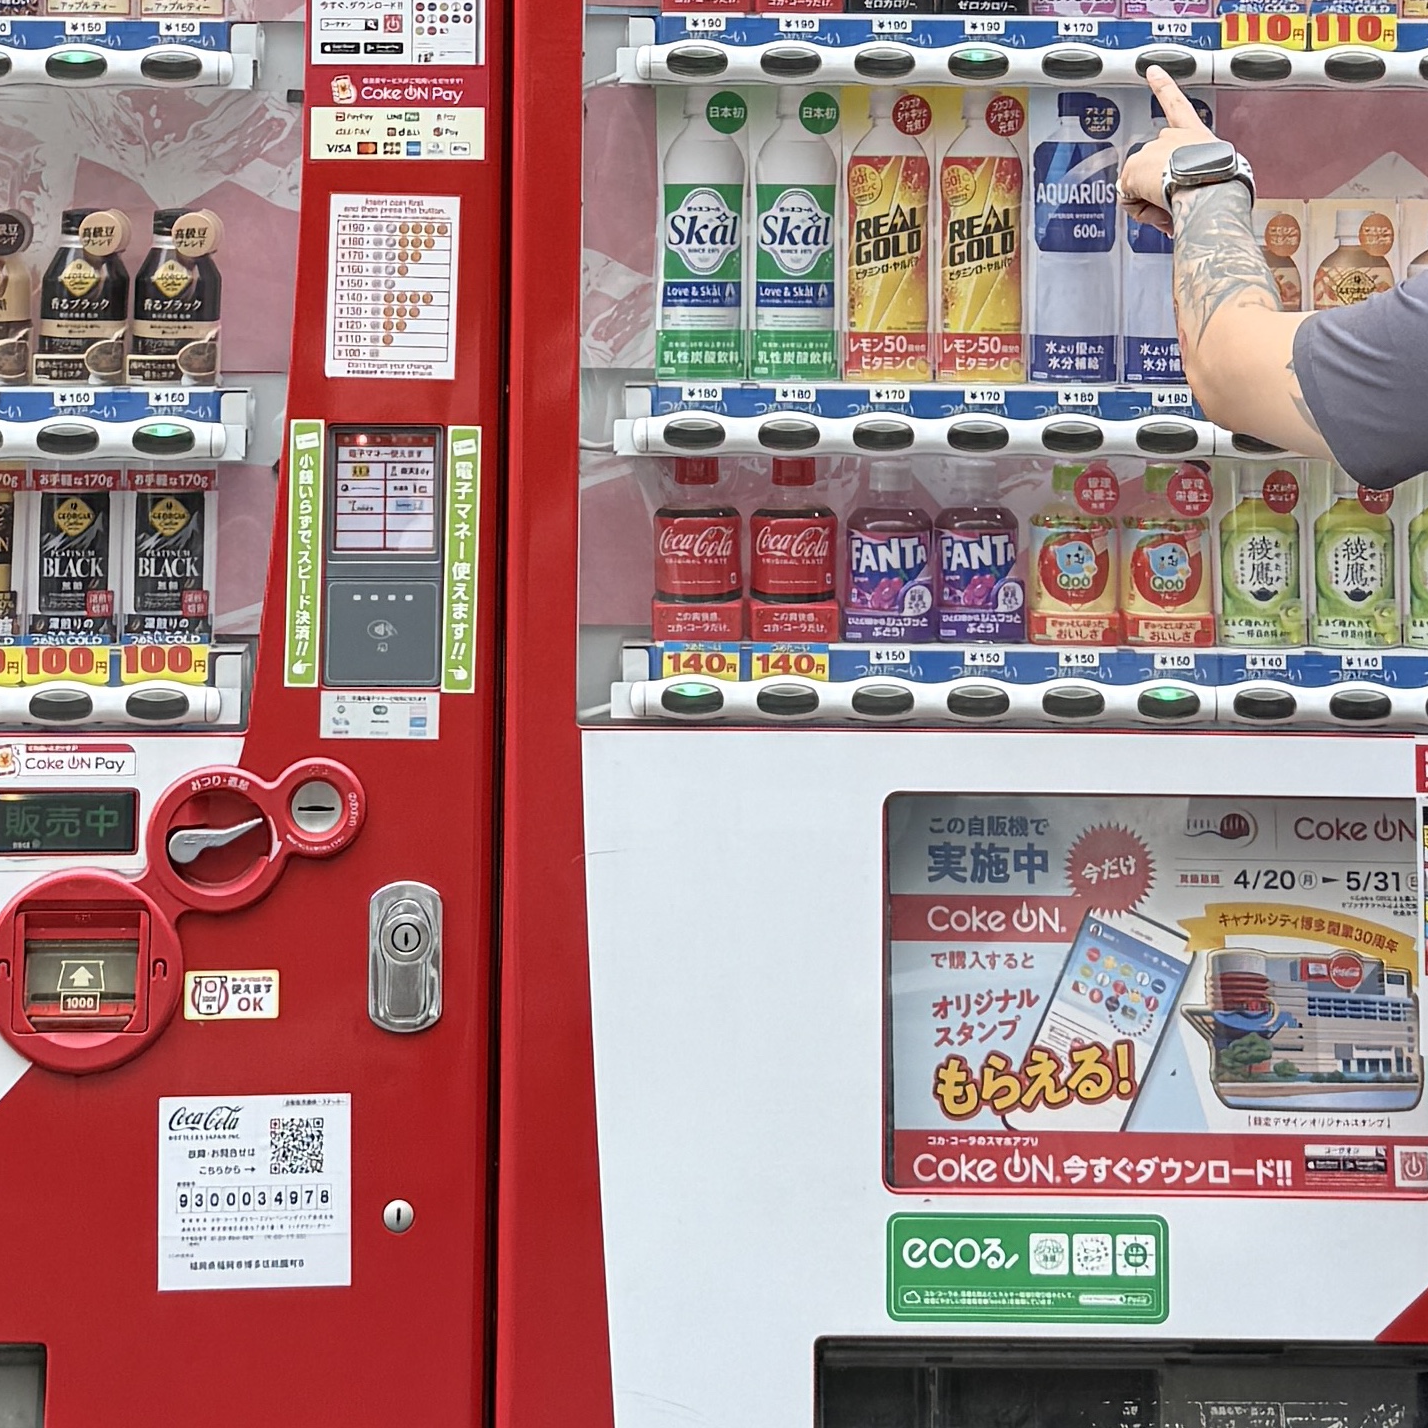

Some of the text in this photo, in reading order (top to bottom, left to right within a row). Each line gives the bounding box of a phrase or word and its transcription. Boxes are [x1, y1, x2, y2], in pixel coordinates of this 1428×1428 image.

[61, 1, 116, 11] アップルティー
[1063, 22, 1094, 33] ¥170
[1225, 14, 1305, 42] 110円
[1315, 14, 1394, 42] 110円
[361, 82, 464, 105] Coke ON Pay
[708, 106, 746, 121] 日本初
[801, 106, 837, 121] 日本初
[1036, 181, 1115, 206] AQUARIUS
[82, 225, 116, 238] 高級豆
[667, 213, 738, 248] Skål
[760, 213, 833, 248] Skål
[855, 203, 921, 242] REAL
[855, 229, 921, 266] GOLD
[949, 230, 1014, 267] GOLD
[50, 298, 111, 311] 香るブラック
[143, 298, 203, 312] 香るブラック
[664, 350, 740, 365] 乳性炭酸飲料
[758, 350, 833, 365] 乳性炭酸飲料
[1045, 341, 1104, 356] 水より優れた
[860, 355, 916, 369] ビタミンC
[954, 356, 1009, 370] ビタミンC
[1047, 355, 1100, 371] 水分補給
[294, 453, 315, 659] 小銭いらずで、スピード決済!!
[451, 461, 475, 661] 電子マネー使えます!!
[850, 534, 927, 573] FANTA
[42, 556, 104, 578] BLACK
[1056, 572, 1090, 591] Qoo
[1151, 574, 1185, 592] Qoo
[1056, 628, 1100, 641] おいしさ
[1150, 630, 1193, 642] おいしさ
[667, 652, 737, 675] 140円
[754, 653, 825, 675] 140円
[25, 755, 126, 775] Coke ON Pay
[5, 805, 120, 839] 販売中
[928, 815, 1049, 838] この自販機で
[927, 842, 1049, 883] 実施中
[1081, 854, 1138, 884] 今だけ
[1217, 910, 1400, 956] キャナルシティ博多開業30周年
[931, 950, 1035, 971] で購入すると
[65, 996, 94, 1010] 1000
[237, 996, 264, 1012] OK
[932, 986, 1040, 1020] オリジナル
[934, 1015, 1023, 1048] スタンプ
[934, 1039, 1138, 1120] もらえる!
[927, 1135, 1039, 1148] コカ・コーラのスマホアプリ
[913, 1154, 997, 1183] Coke
[1062, 1157, 1293, 1187] 今すぐダウンロード!!
